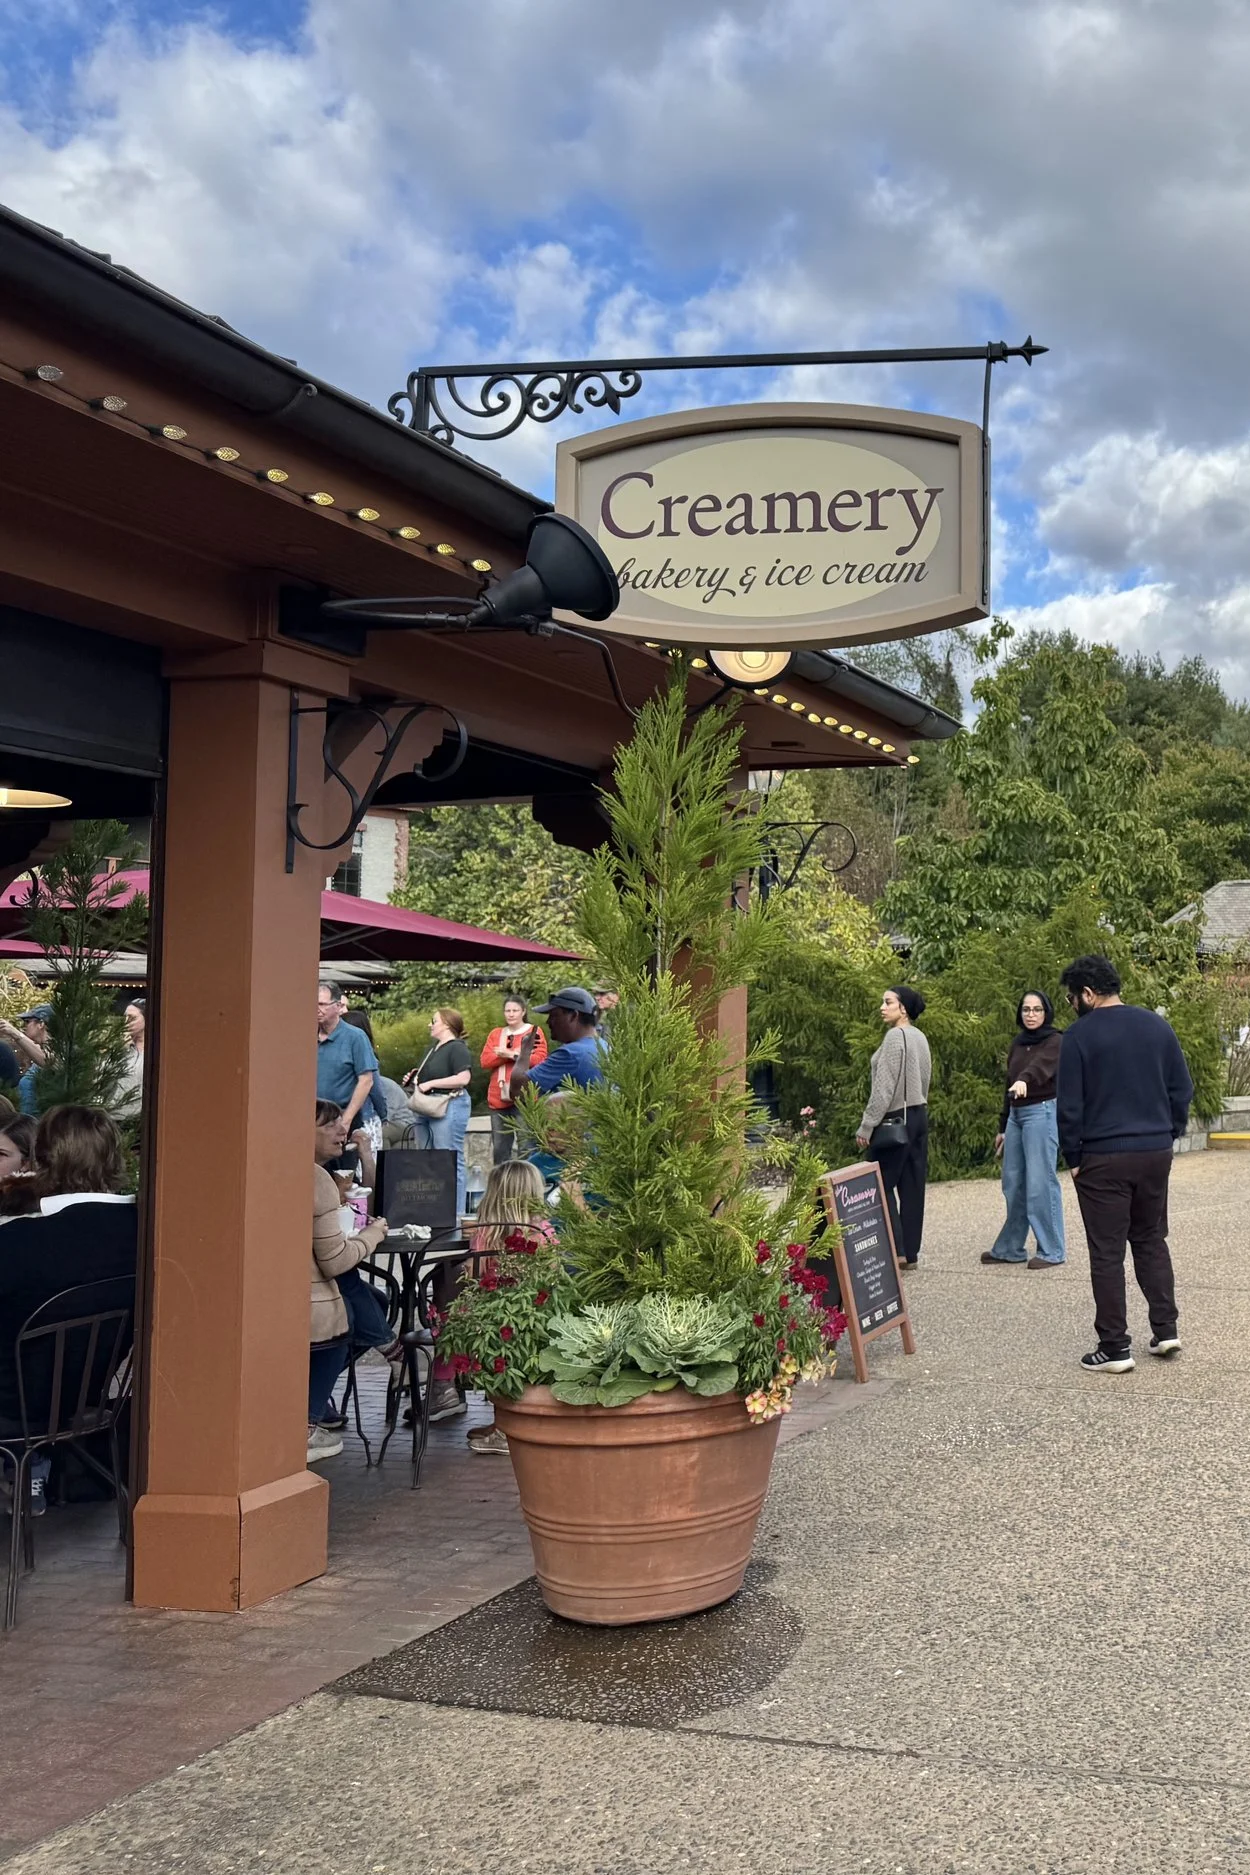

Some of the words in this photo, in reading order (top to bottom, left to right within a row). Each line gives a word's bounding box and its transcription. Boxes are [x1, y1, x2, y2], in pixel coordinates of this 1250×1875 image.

[601, 472, 944, 556] Creamery
[616, 557, 737, 604] bakery
[739, 566, 757, 595] &
[765, 558, 815, 587] ice
[823, 557, 928, 585] cream
[854, 1235, 878, 1252] SANDWICHES
[874, 1309, 884, 1321] BEER
